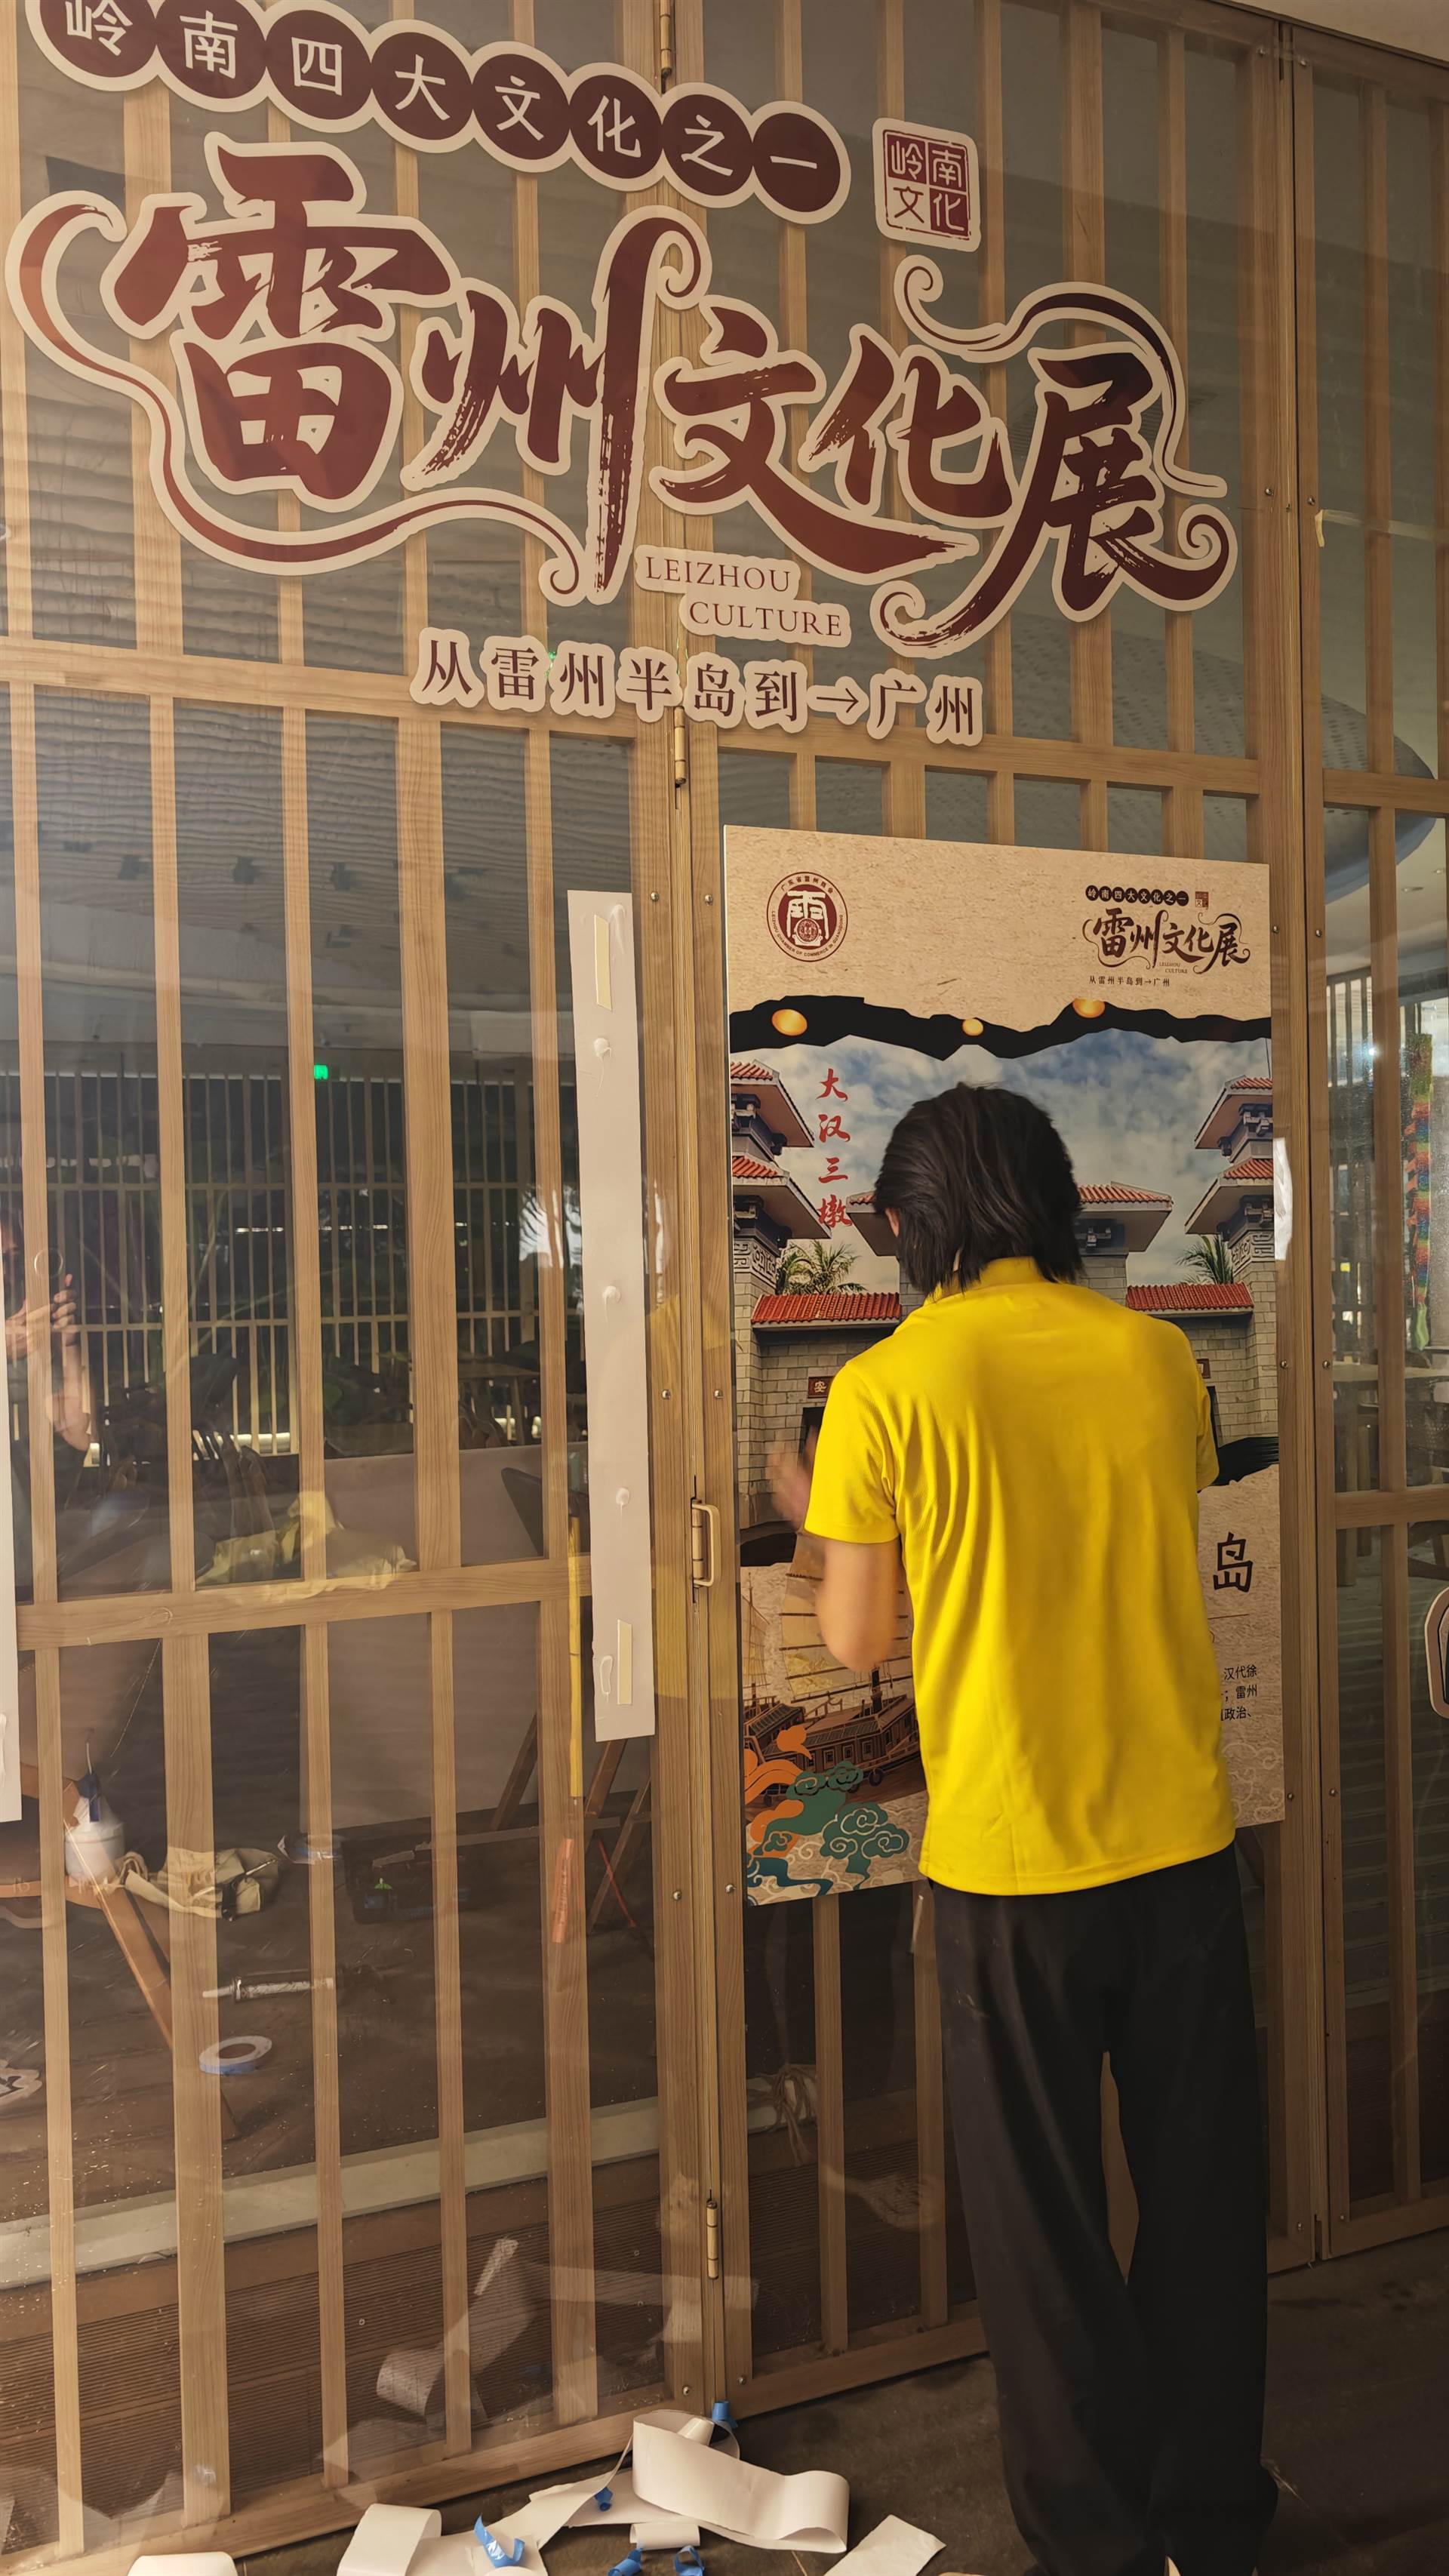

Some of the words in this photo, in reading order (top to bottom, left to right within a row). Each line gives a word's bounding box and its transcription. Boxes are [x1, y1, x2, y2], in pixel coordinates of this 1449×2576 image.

[65, 0, 818, 177] 岭南四大文化之一
[891, 140, 963, 189] 岭南
[893, 186, 965, 232] 文化
[112, 143, 1233, 645] 雷州文化展
[645, 556, 791, 593] LEIZHOU
[688, 601, 843, 638] CULTURE
[420, 639, 800, 725] 从雷州半岛到
[877, 679, 975, 736] 广州
[1088, 887, 1186, 904] 岭南四大文化之一
[777, 933, 795, 953] CHAMBER
[804, 946, 829, 957] COMMERCE
[1092, 907, 1251, 974] 雷州文化展
[815, 1067, 853, 1228] 大汉三墩
[1213, 1531, 1254, 1593] 岛
[1221, 1684, 1257, 1702] ；雷州
[1223, 1664, 1257, 1680] 汉代徐
[1221, 1706, 1251, 1721] 政治、
